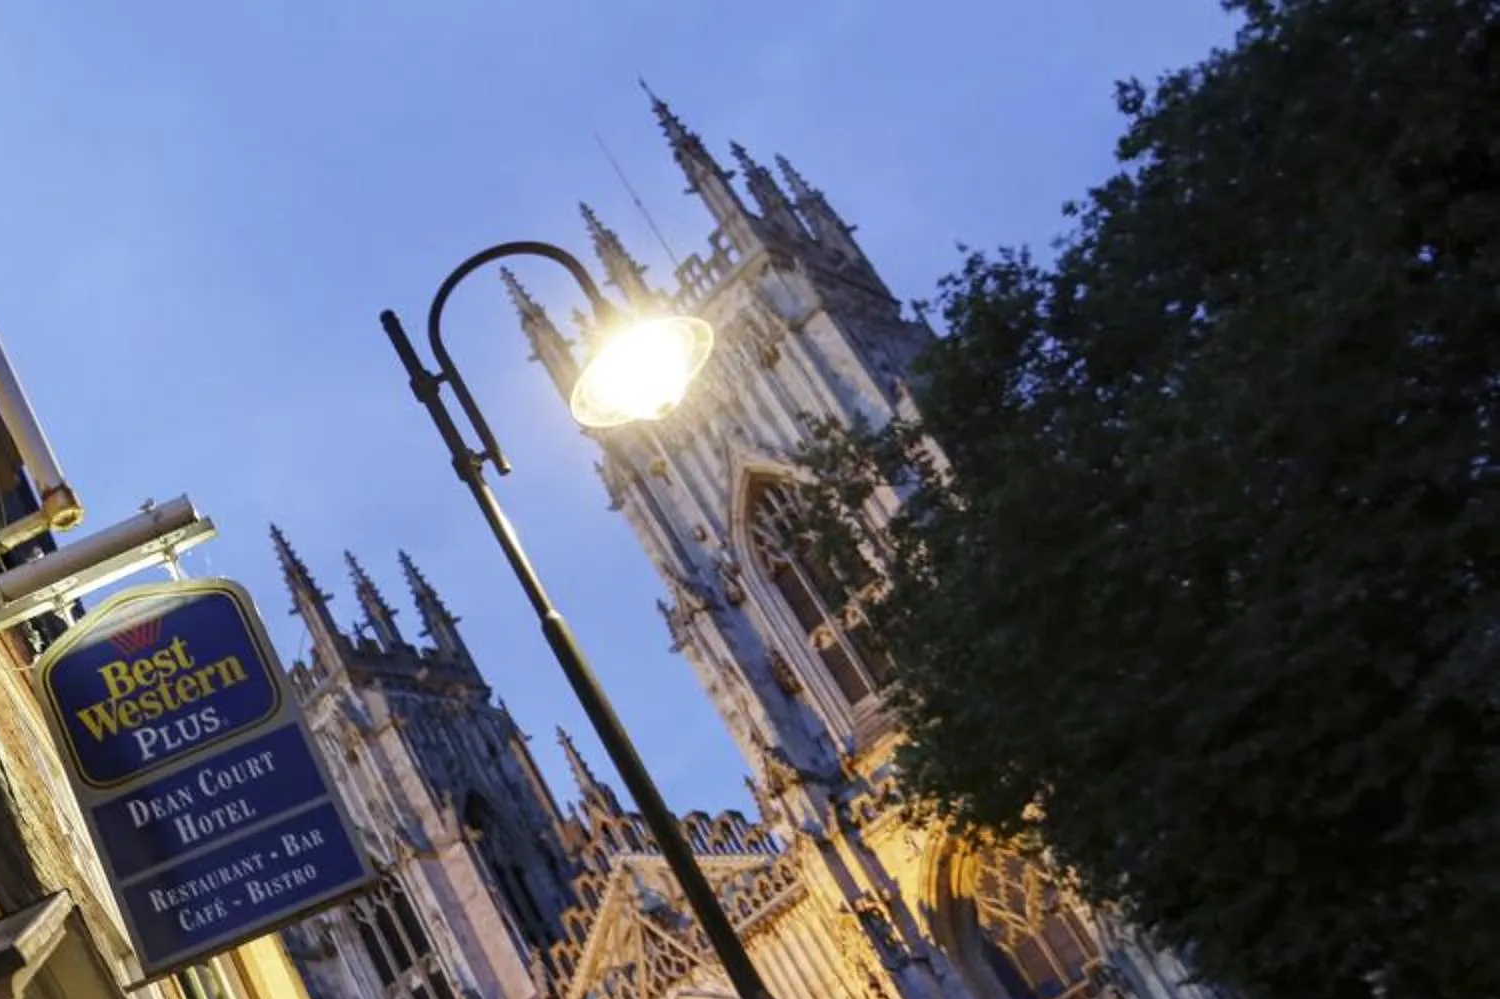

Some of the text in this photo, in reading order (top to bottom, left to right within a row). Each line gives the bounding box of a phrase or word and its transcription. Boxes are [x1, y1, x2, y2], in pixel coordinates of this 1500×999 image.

[77, 655, 248, 743] Western
[98, 636, 195, 700] Best
[132, 706, 220, 761] PLUS
[126, 751, 276, 829] DEAN COURT
[174, 799, 257, 845] HOTEL
[148, 828, 325, 913] RESTAURANT BAR
[245, 863, 318, 904] BISTRO
